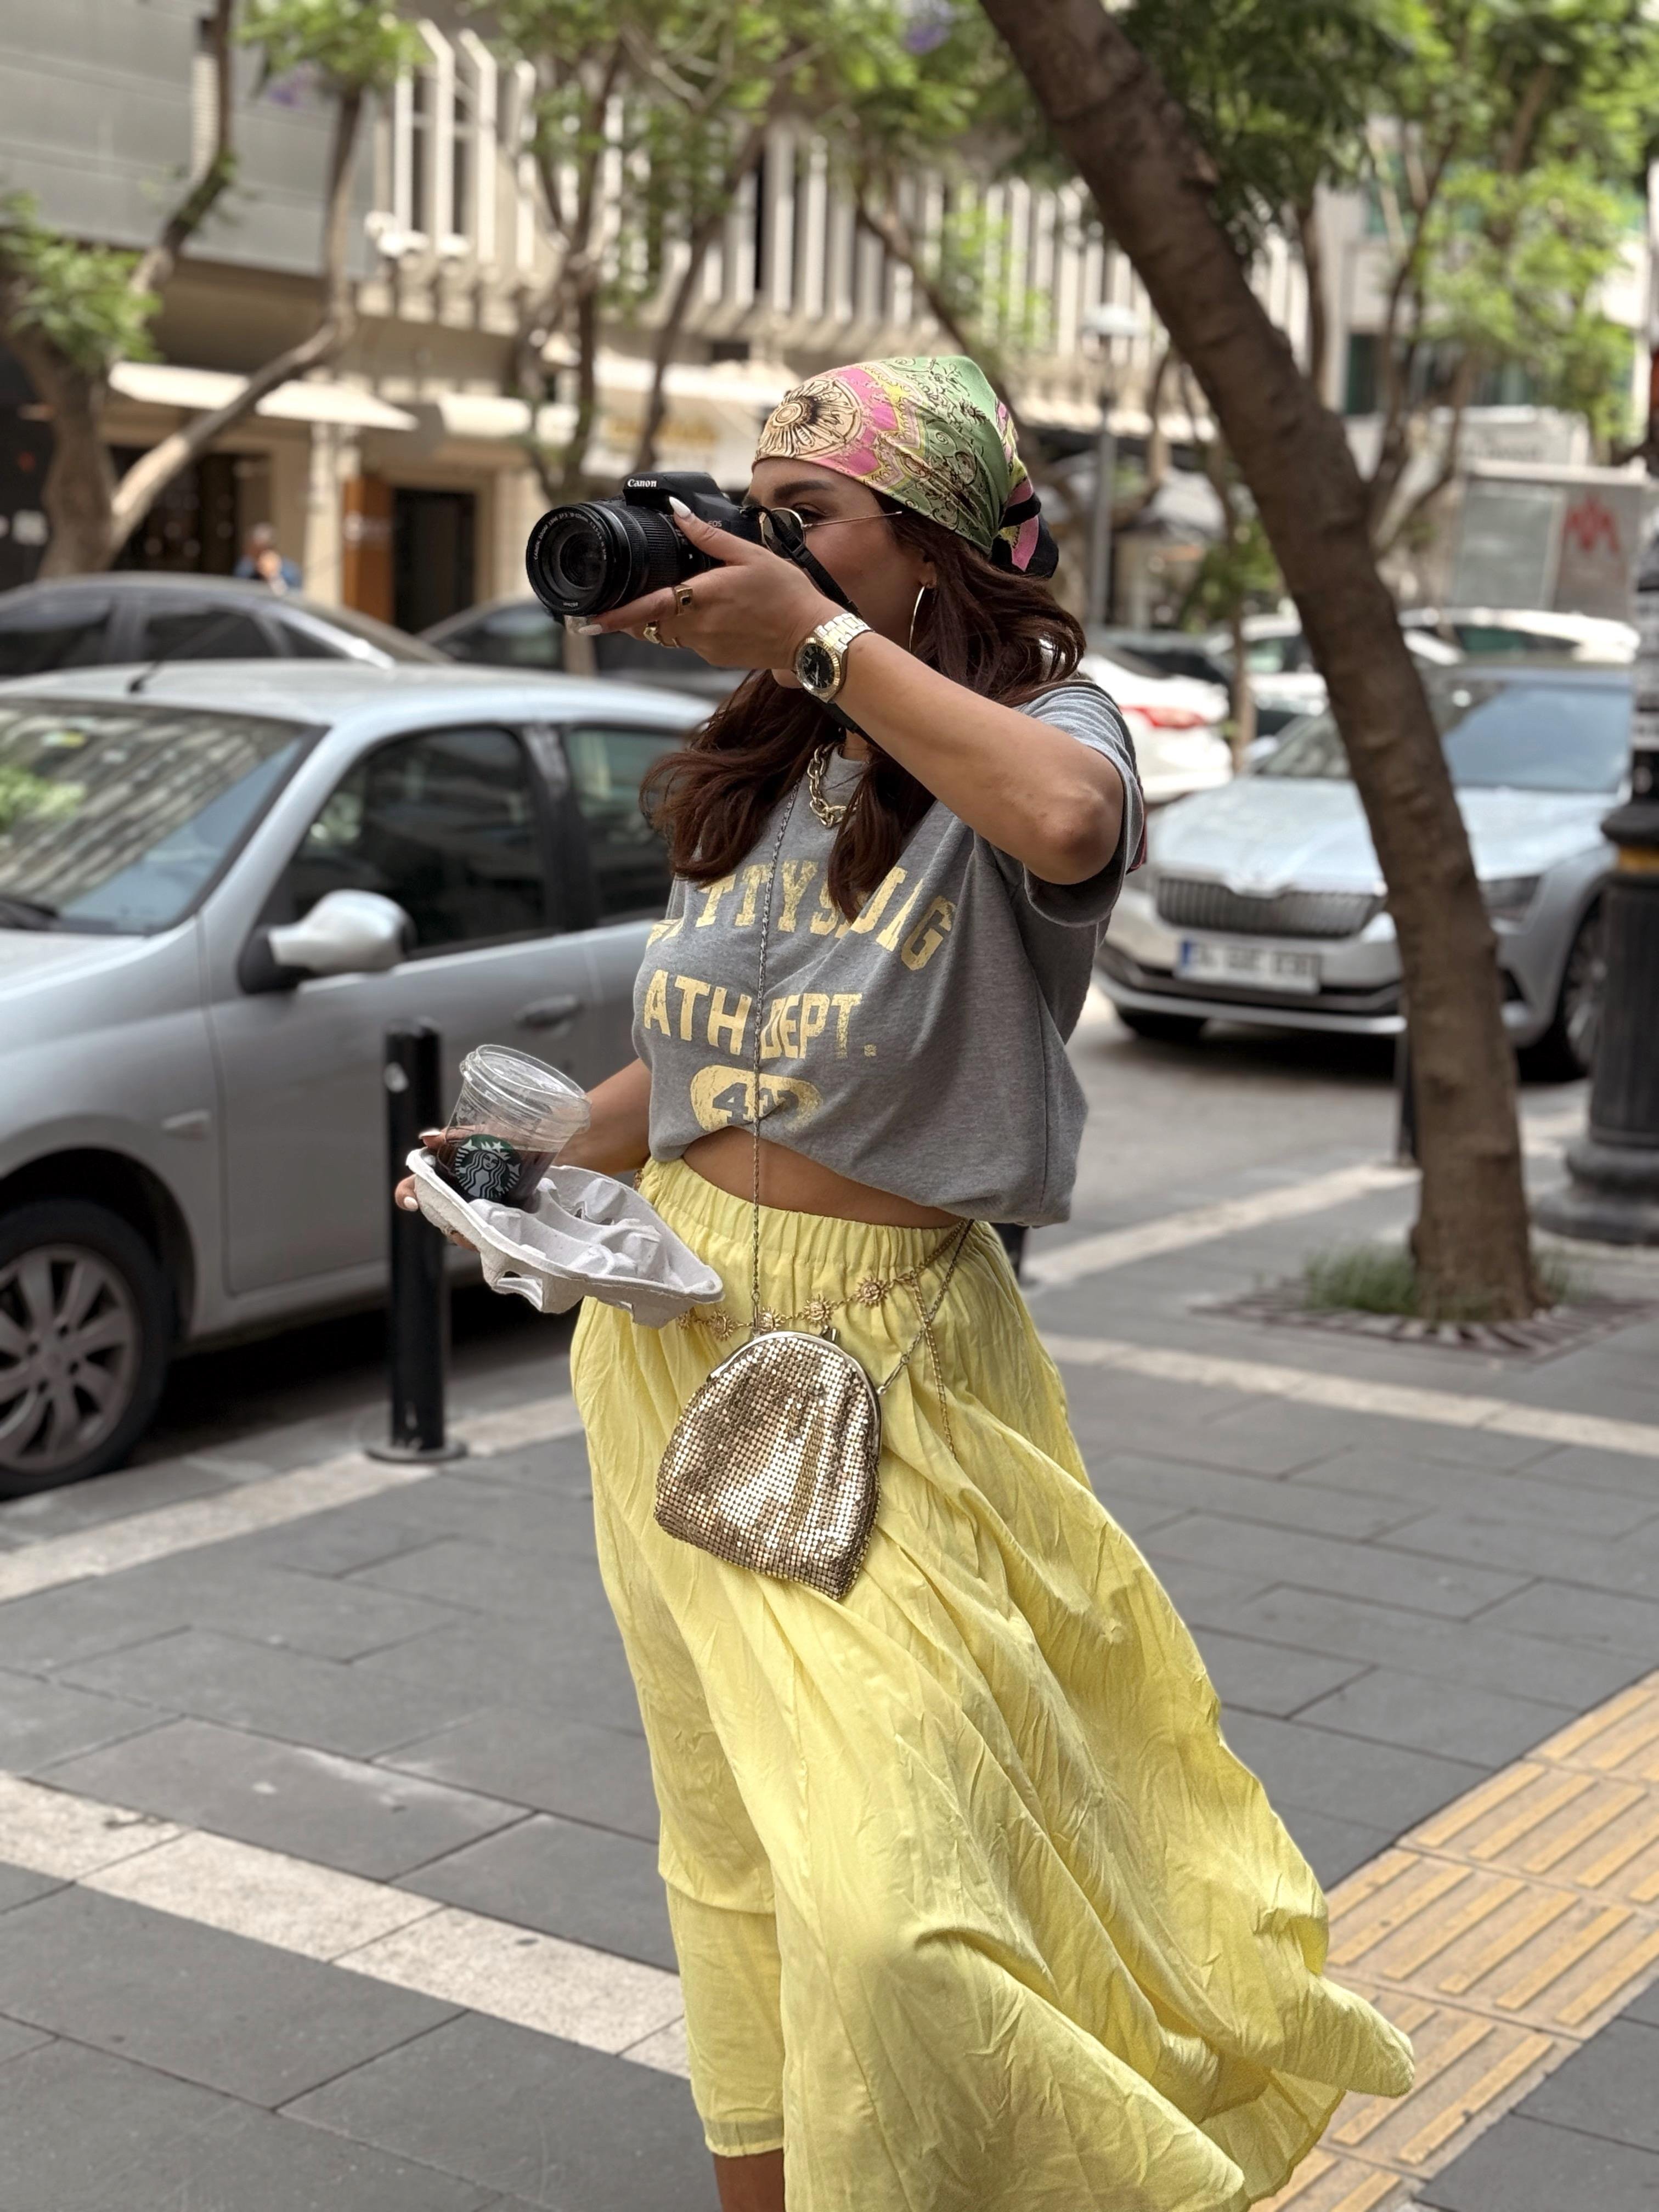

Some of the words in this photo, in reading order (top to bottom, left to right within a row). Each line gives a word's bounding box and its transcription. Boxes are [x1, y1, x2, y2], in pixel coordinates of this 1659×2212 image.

[627, 478, 657, 488] Canon
[644, 969, 753, 1056] ATH
[760, 992, 877, 1059] DEPT.
